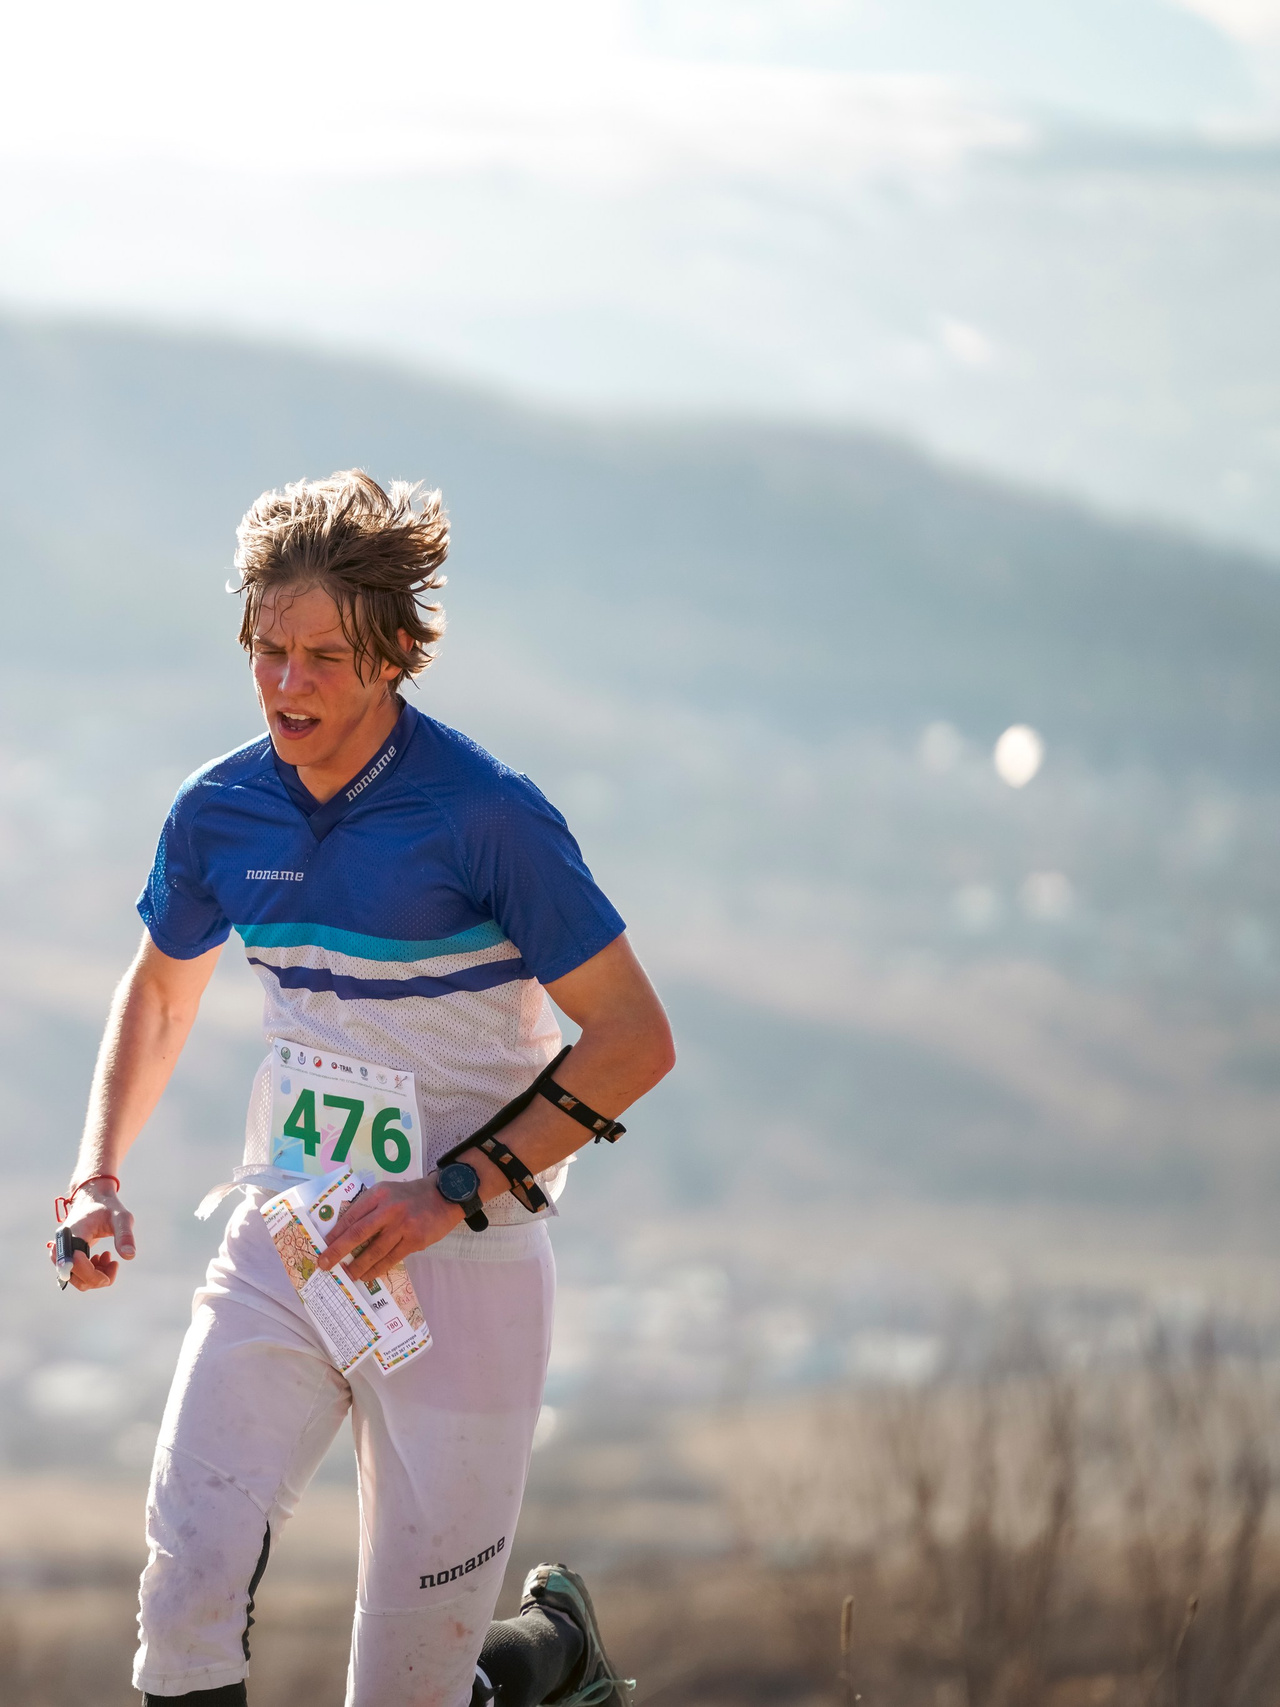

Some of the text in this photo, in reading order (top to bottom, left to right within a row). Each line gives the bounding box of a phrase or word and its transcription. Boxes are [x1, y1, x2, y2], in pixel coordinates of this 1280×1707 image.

[345, 745, 397, 802] noname
[245, 869, 304, 882] noname
[283, 1088, 412, 1174] 476
[420, 1536, 505, 1590] noname
